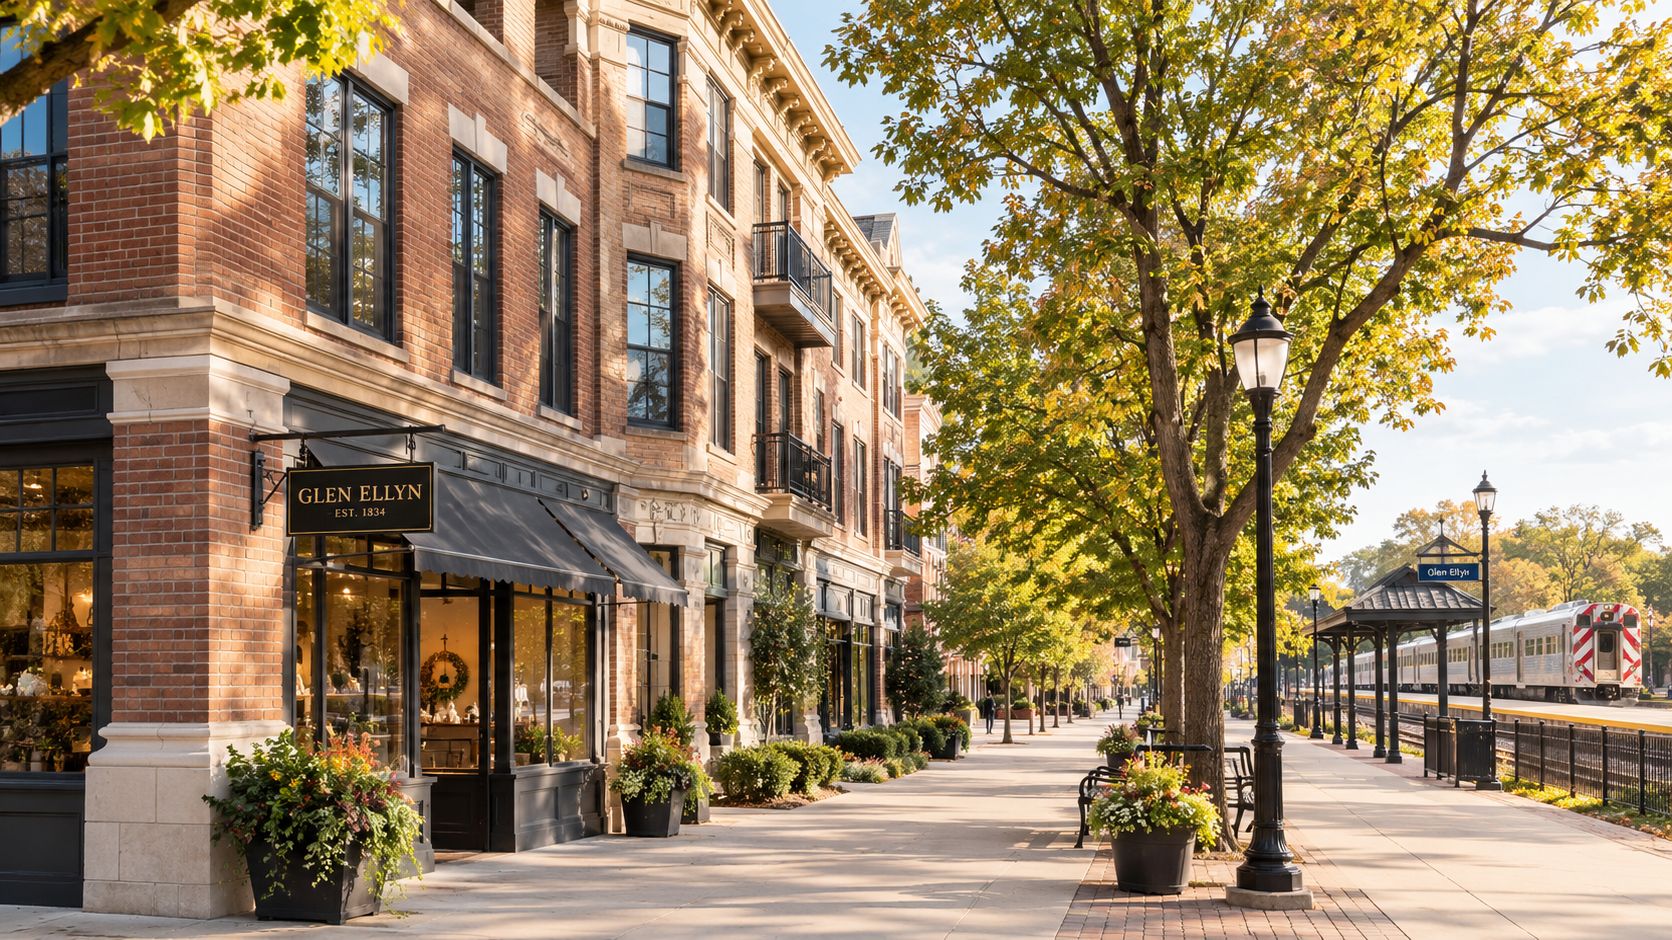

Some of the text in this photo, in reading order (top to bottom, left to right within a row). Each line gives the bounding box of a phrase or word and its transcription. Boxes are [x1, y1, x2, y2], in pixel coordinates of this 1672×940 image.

[298, 483, 423, 504] GLEN ELLYN
[335, 507, 386, 518] EST. 1834
